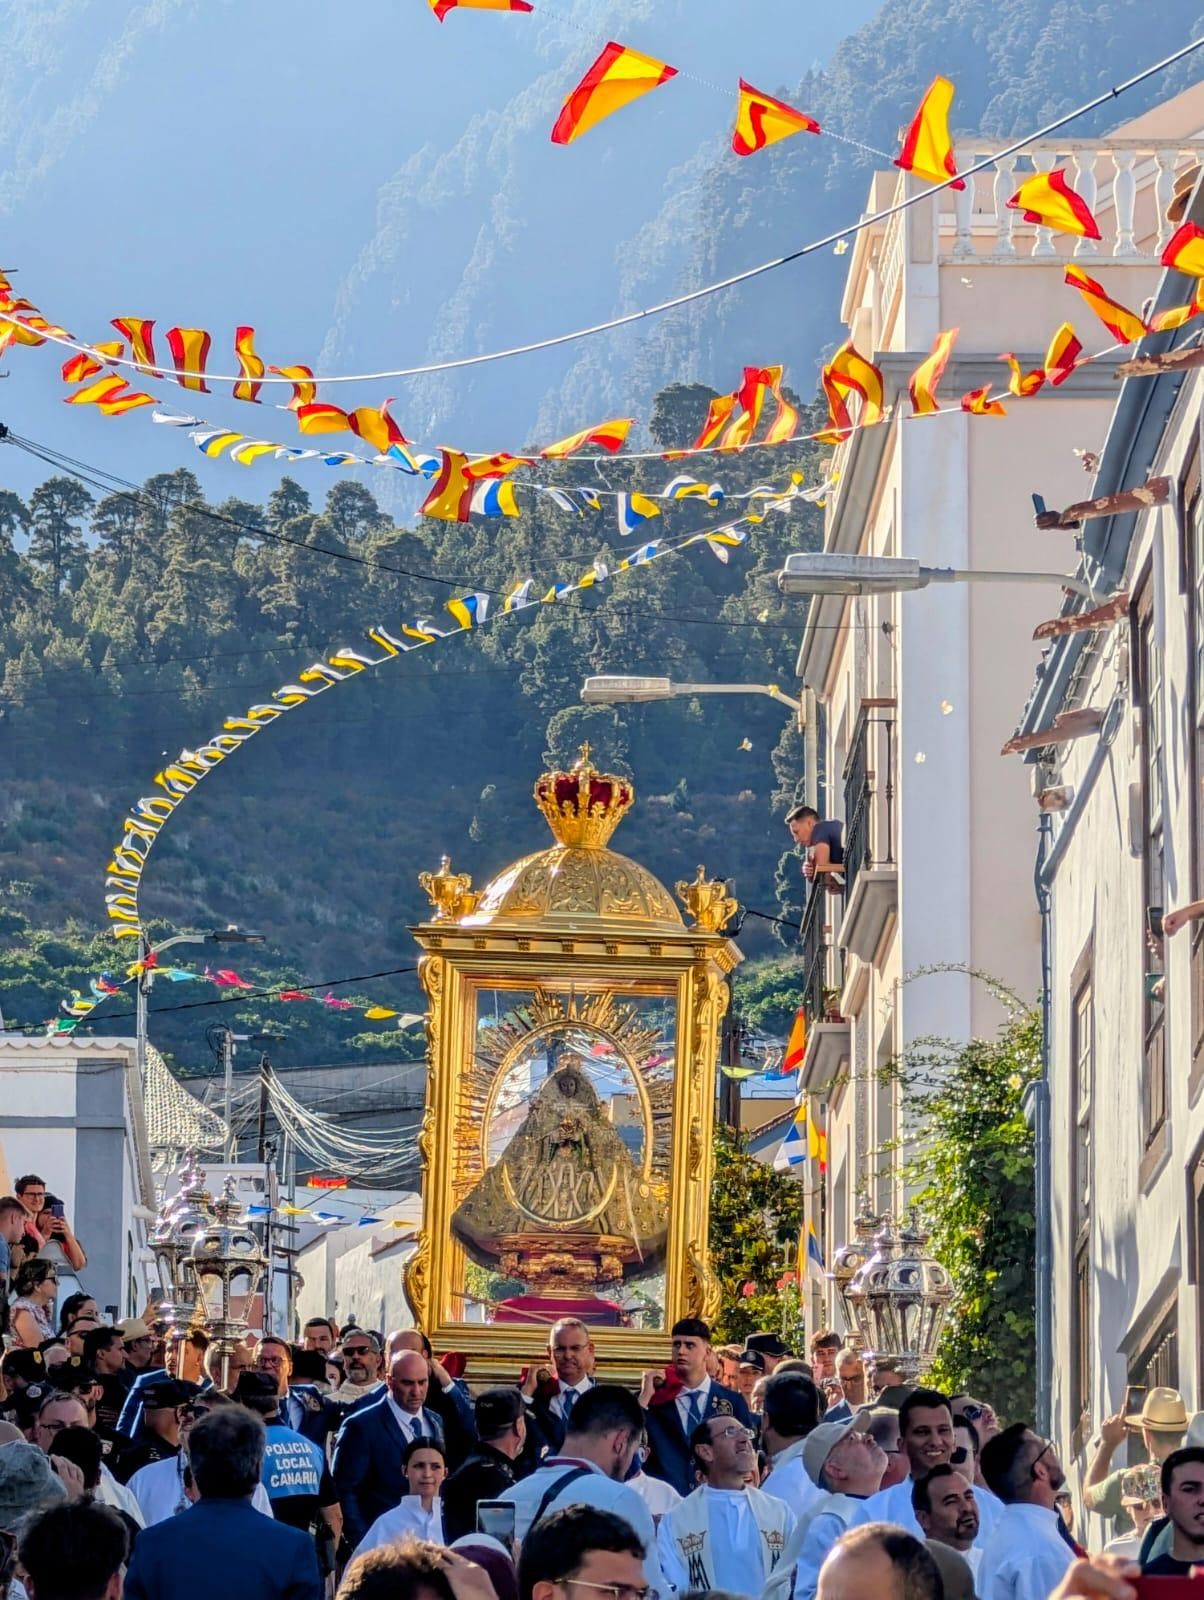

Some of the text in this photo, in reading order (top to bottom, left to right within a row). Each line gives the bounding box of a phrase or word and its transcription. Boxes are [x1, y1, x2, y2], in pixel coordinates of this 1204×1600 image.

[265, 1442, 313, 1456] POLICIA
[276, 1457, 312, 1470] LOCAL
[270, 1471, 318, 1488] CANARIA
